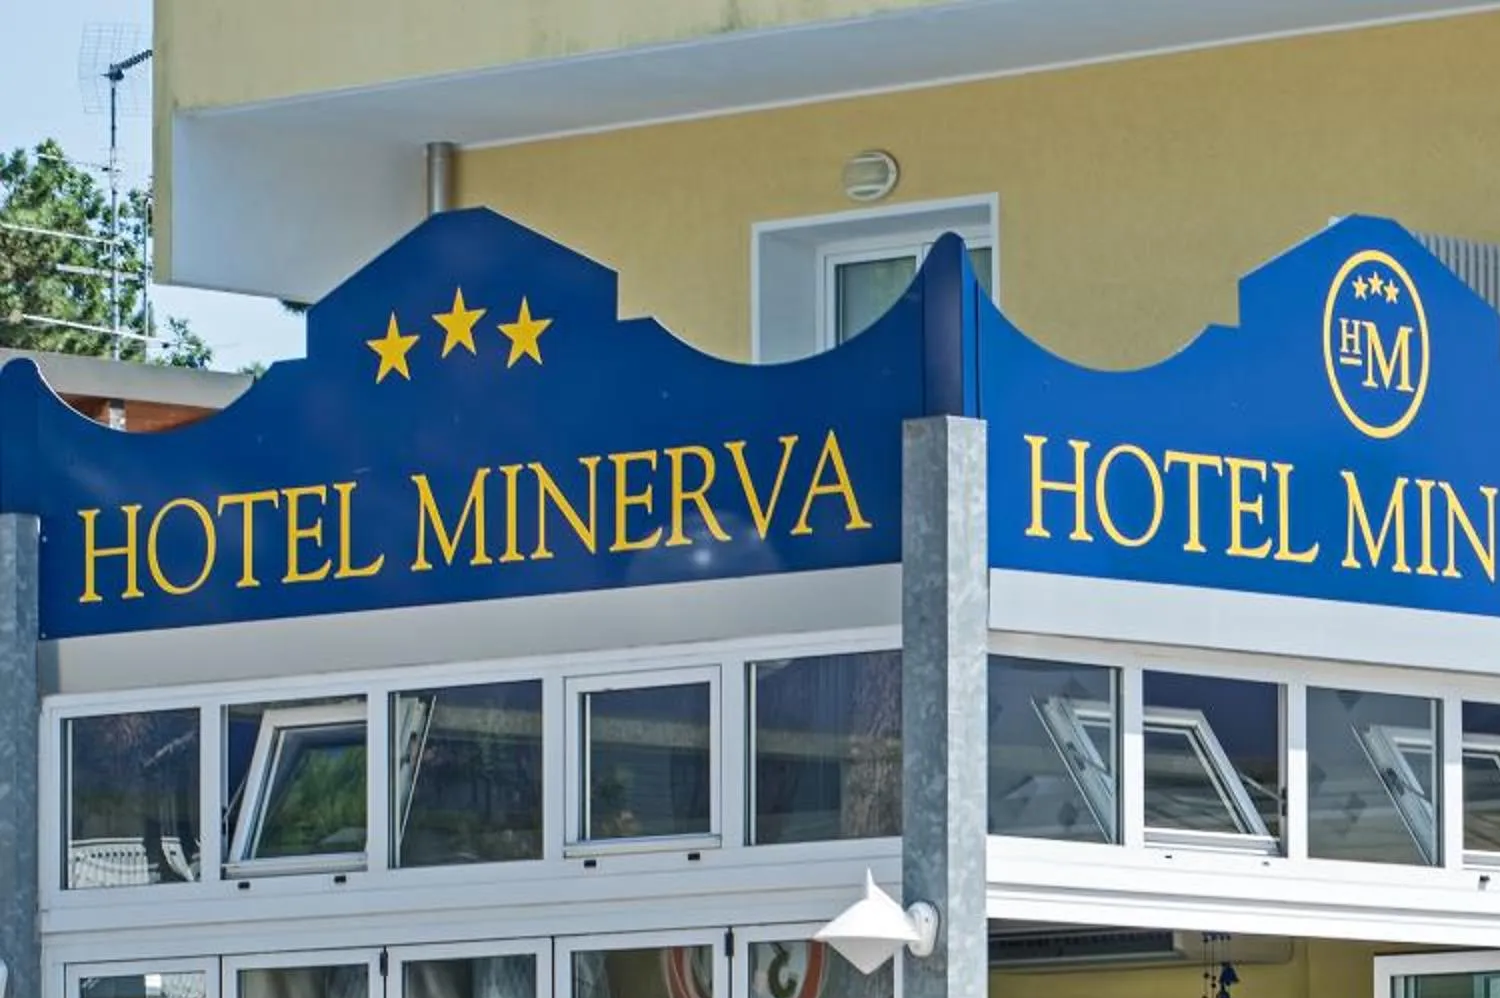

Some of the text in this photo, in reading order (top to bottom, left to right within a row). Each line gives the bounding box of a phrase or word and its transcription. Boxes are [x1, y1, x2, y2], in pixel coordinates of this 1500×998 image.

[79, 430, 872, 603] HOTEL MINERVA
[1024, 435, 1319, 564] HOTEL
